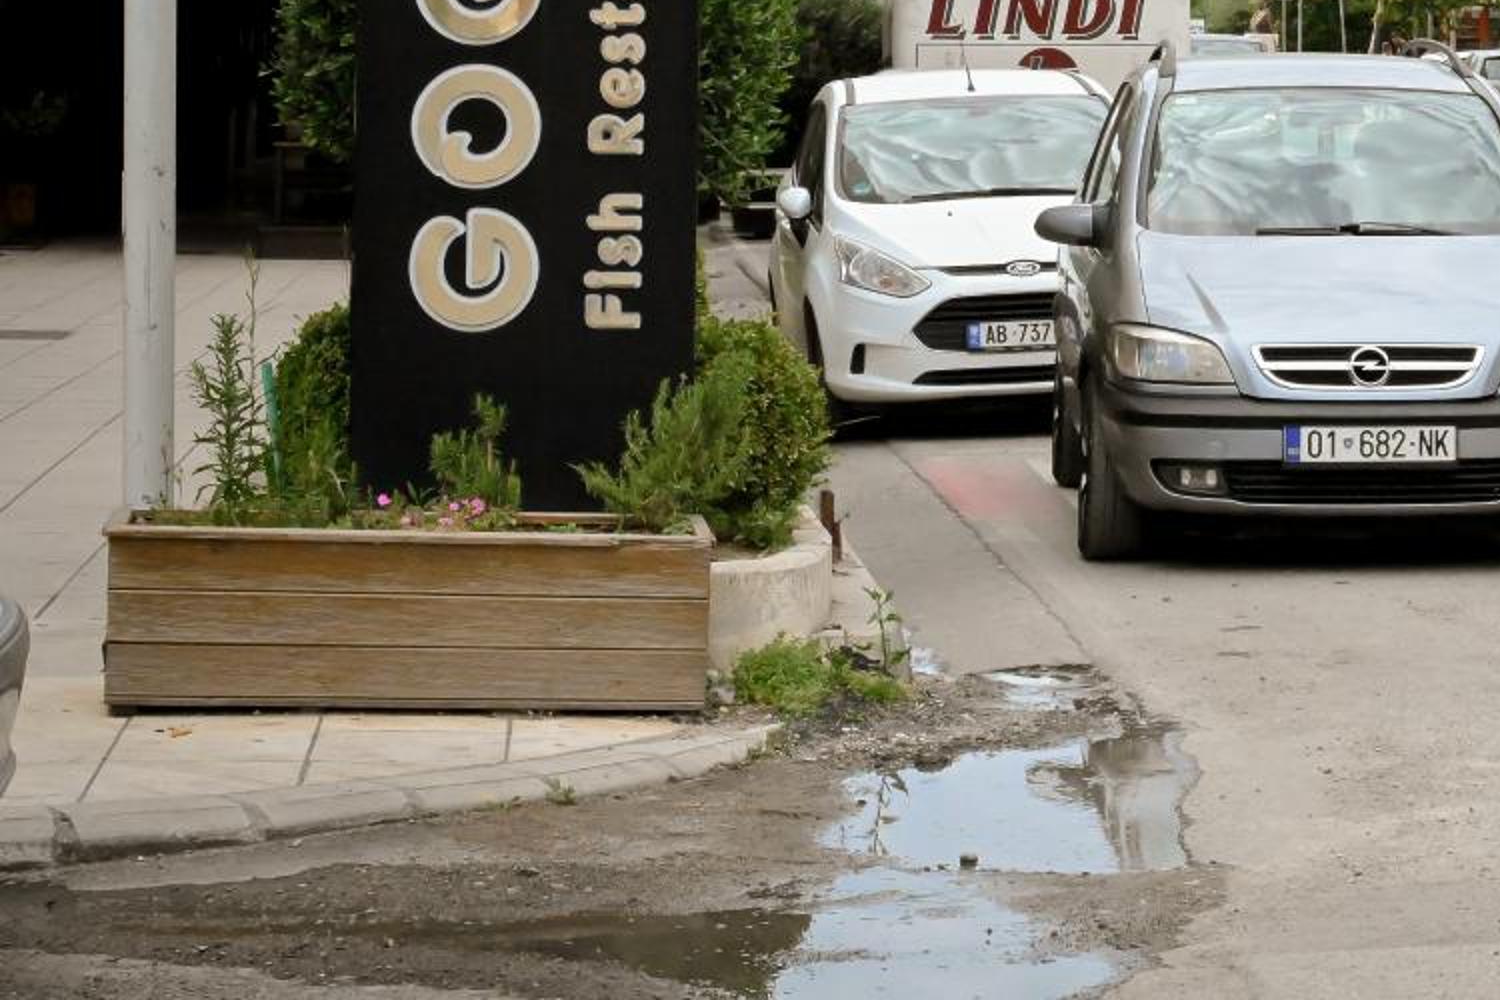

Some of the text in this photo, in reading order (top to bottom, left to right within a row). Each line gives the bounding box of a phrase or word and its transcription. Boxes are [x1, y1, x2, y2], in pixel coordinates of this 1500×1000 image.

[985, 322, 1052, 345] AB 737
[1307, 430, 1337, 459] 01
